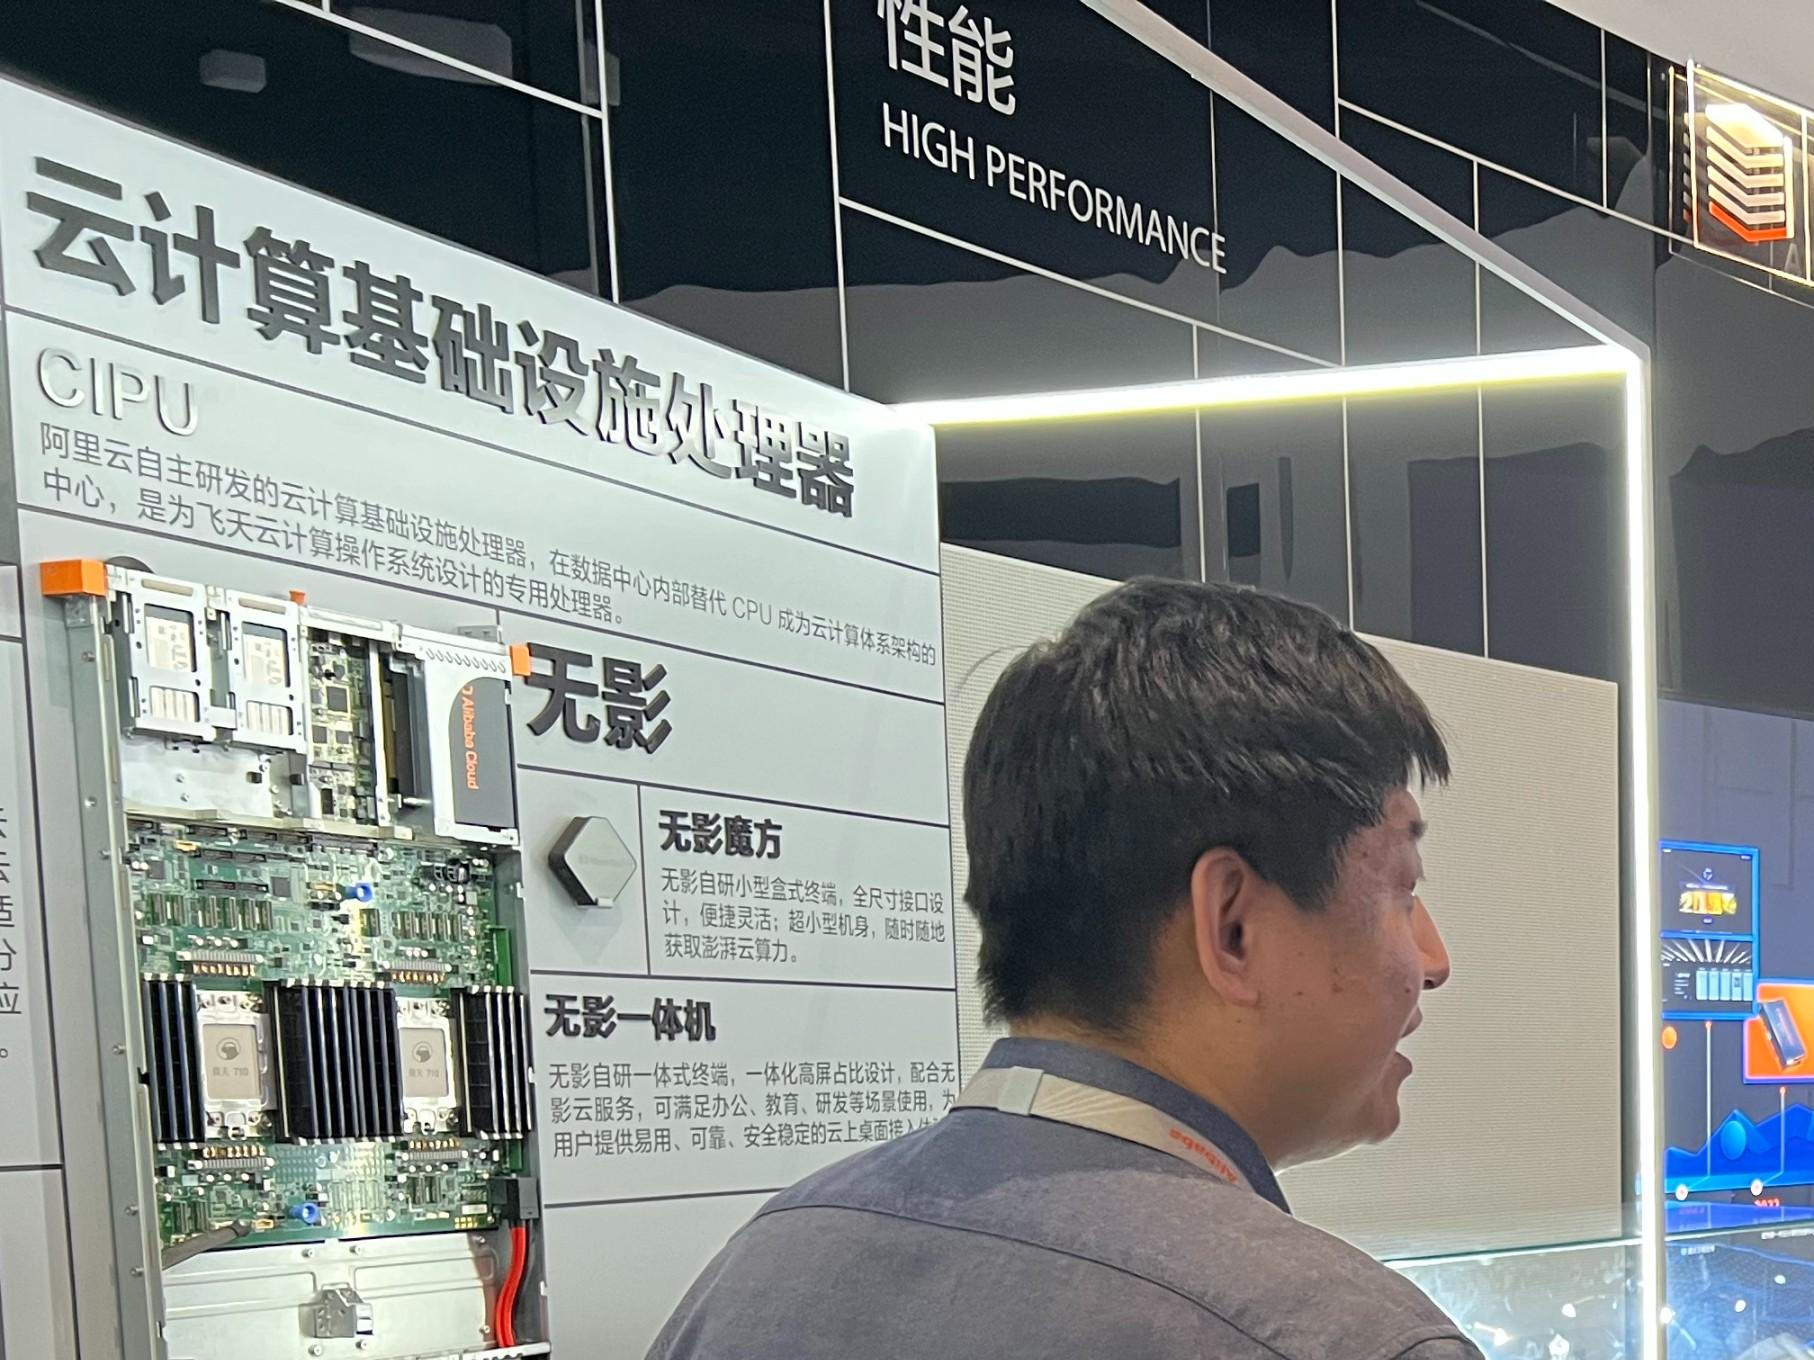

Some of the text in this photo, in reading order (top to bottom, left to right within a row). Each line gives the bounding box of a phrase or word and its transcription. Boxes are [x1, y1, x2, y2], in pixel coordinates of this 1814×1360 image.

[877, 0, 1016, 115] 性能
[883, 102, 1227, 274] HIGH PERFORMANCE
[26, 157, 855, 518] 云计算基础设施处理器
[37, 347, 202, 438] CIPU
[43, 467, 623, 625] 中心，是为飞天云计算操作系统设计的专用处理器。
[732, 596, 772, 625] CPU
[778, 608, 936, 666] 成为云计算体系架构的
[462, 695, 479, 790] Alibaba Cloud
[526, 642, 673, 754] 无影
[659, 810, 782, 859] 无影魔方
[661, 867, 945, 914] 无影自研小型盒式终端，全尺寸接口设
[664, 933, 797, 963] 获取澎湃云算力。
[544, 994, 716, 1041] 无影一体机
[549, 1061, 955, 1089] 无影自研一体式终端，一体化高屏占比设计，配合无
